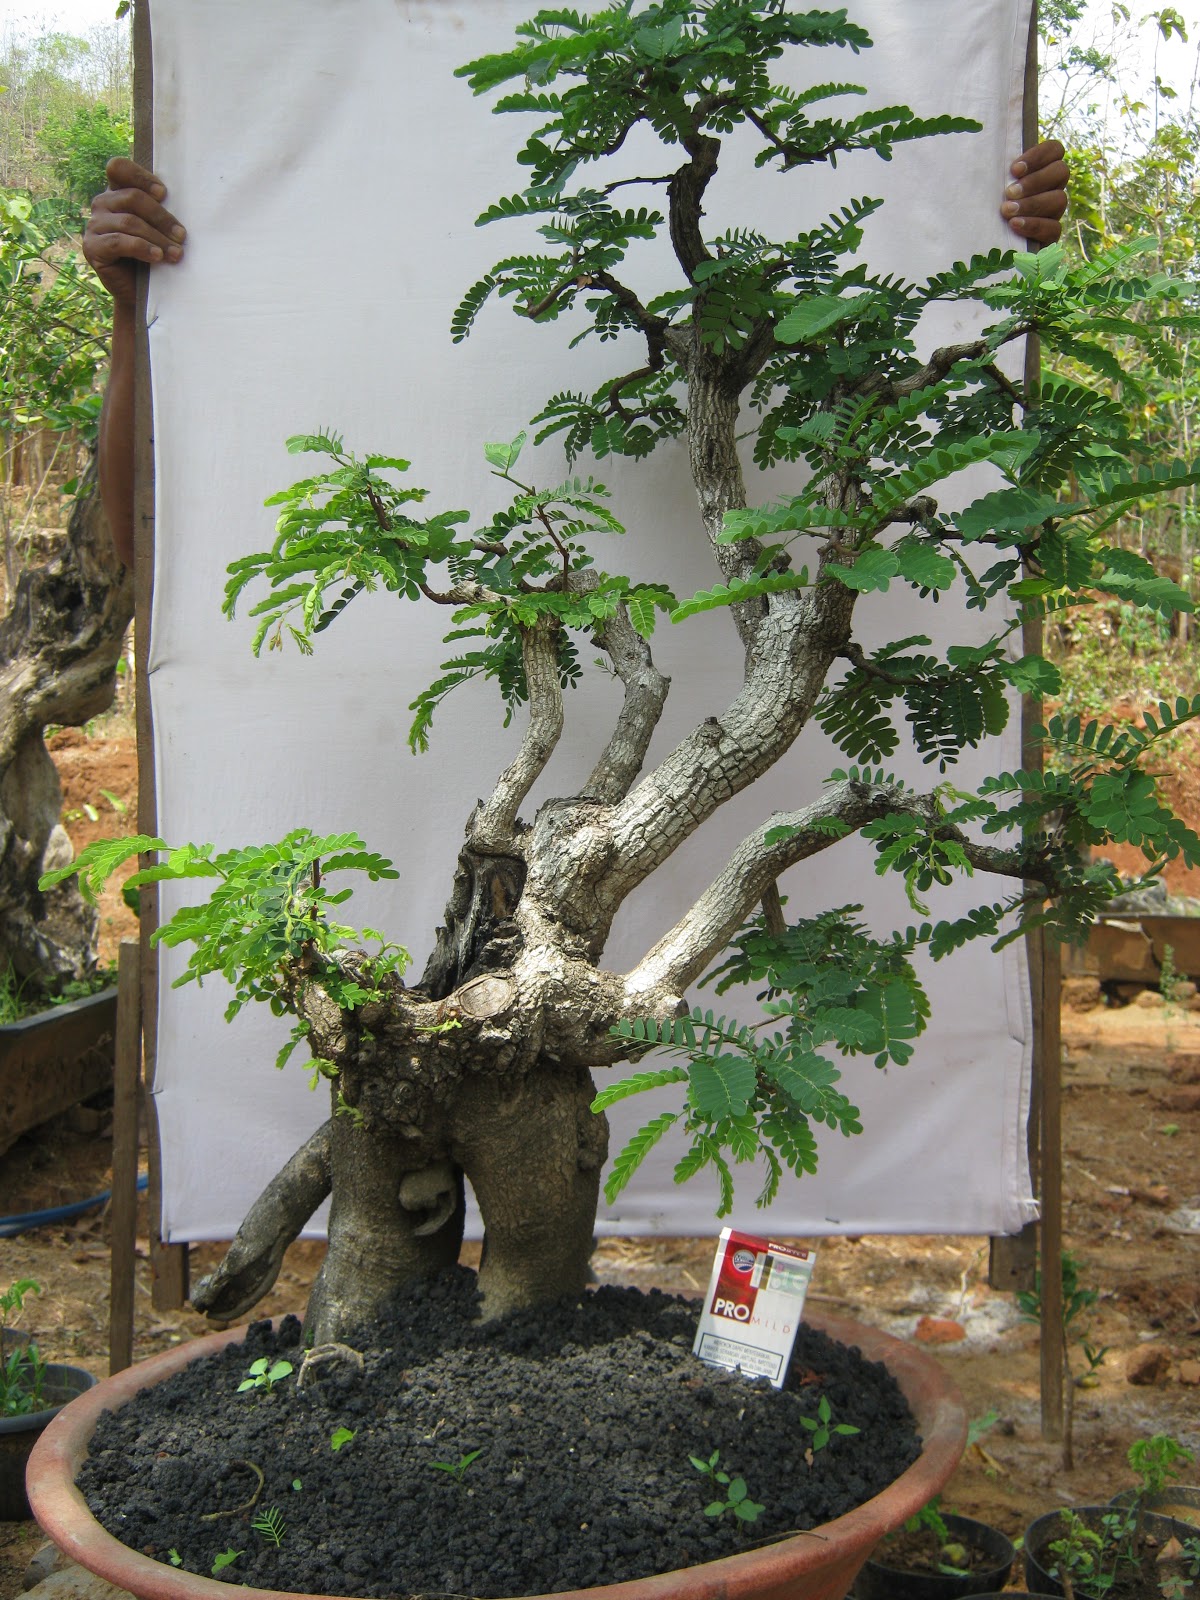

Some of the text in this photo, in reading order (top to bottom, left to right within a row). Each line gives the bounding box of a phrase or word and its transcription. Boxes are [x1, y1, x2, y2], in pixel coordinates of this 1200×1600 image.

[768, 1243, 787, 1252] PRO
[714, 1298, 791, 1334] PRO MILD
